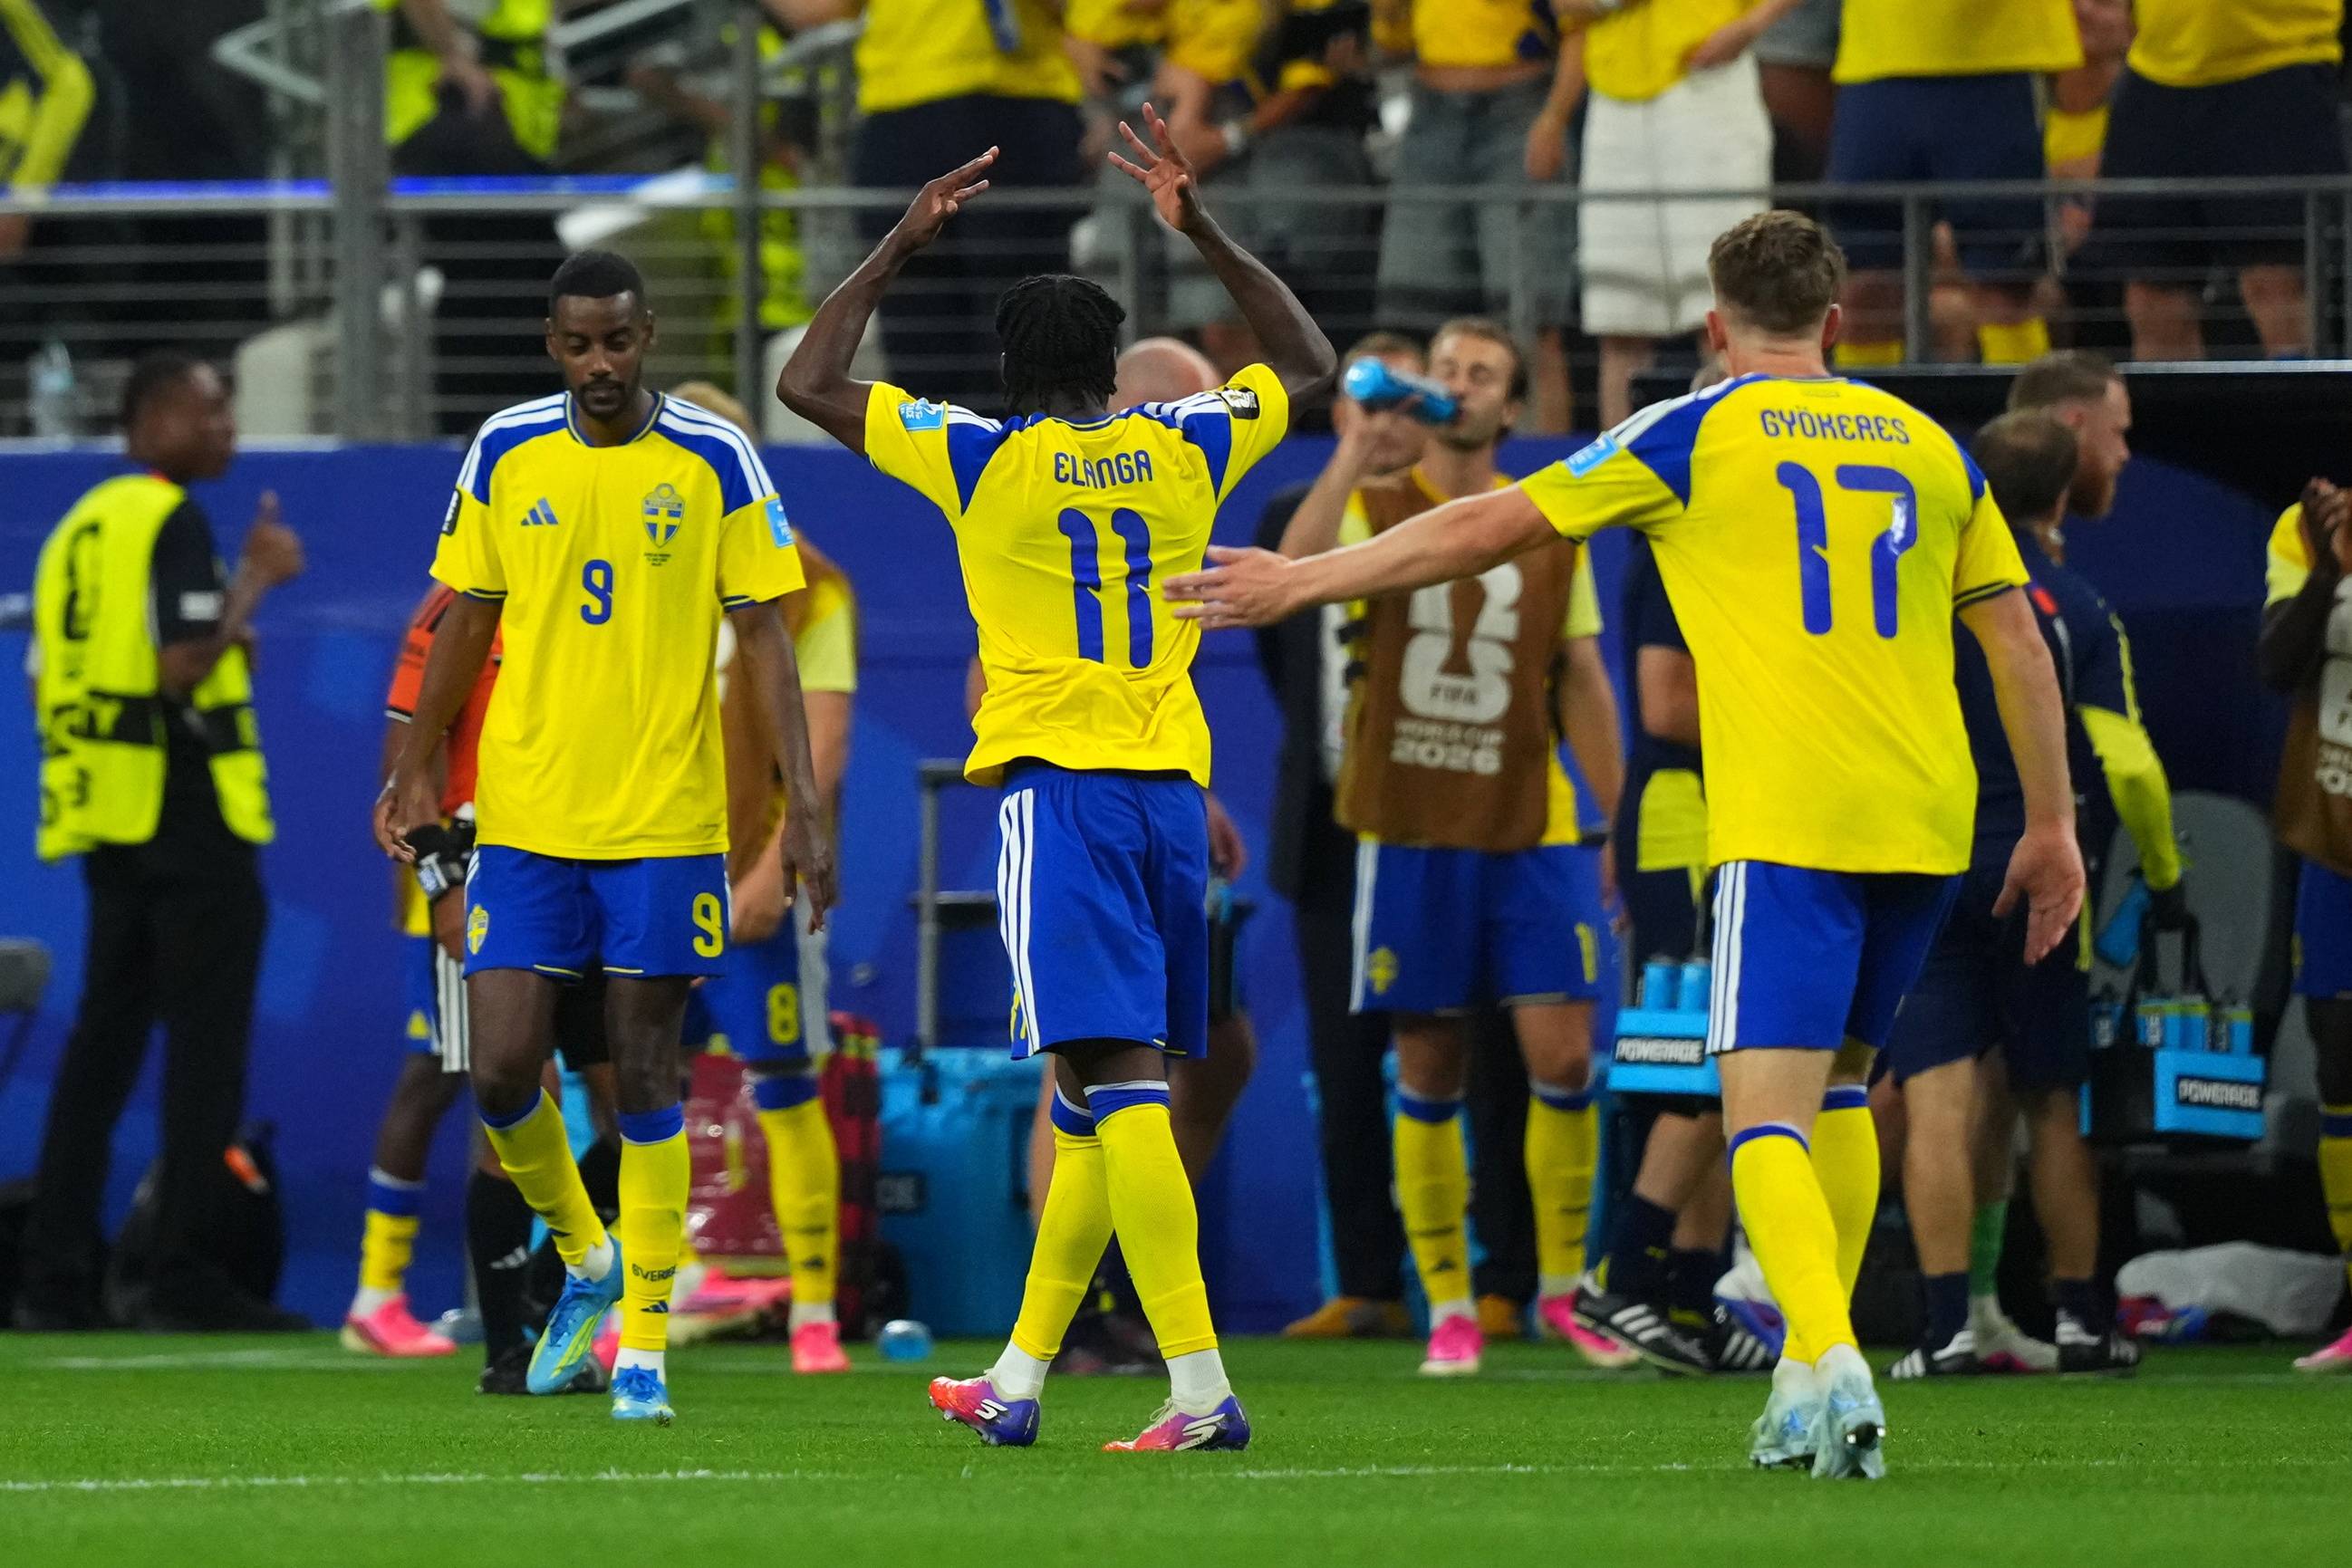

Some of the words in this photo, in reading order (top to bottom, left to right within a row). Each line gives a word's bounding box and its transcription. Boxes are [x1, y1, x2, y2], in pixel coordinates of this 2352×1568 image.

[1760, 405, 1911, 445] GYÖKERES
[1054, 449, 1153, 488] ELANGA
[1776, 460, 1918, 640] 17
[581, 558, 613, 626] 9
[1057, 506, 1153, 669] 11
[1391, 739, 1503, 775] 2026
[691, 891, 724, 958] 9
[766, 981, 801, 1046] 8
[1615, 1037, 1703, 1064] POWERADE
[2178, 1078, 2261, 1110] POWERADE
